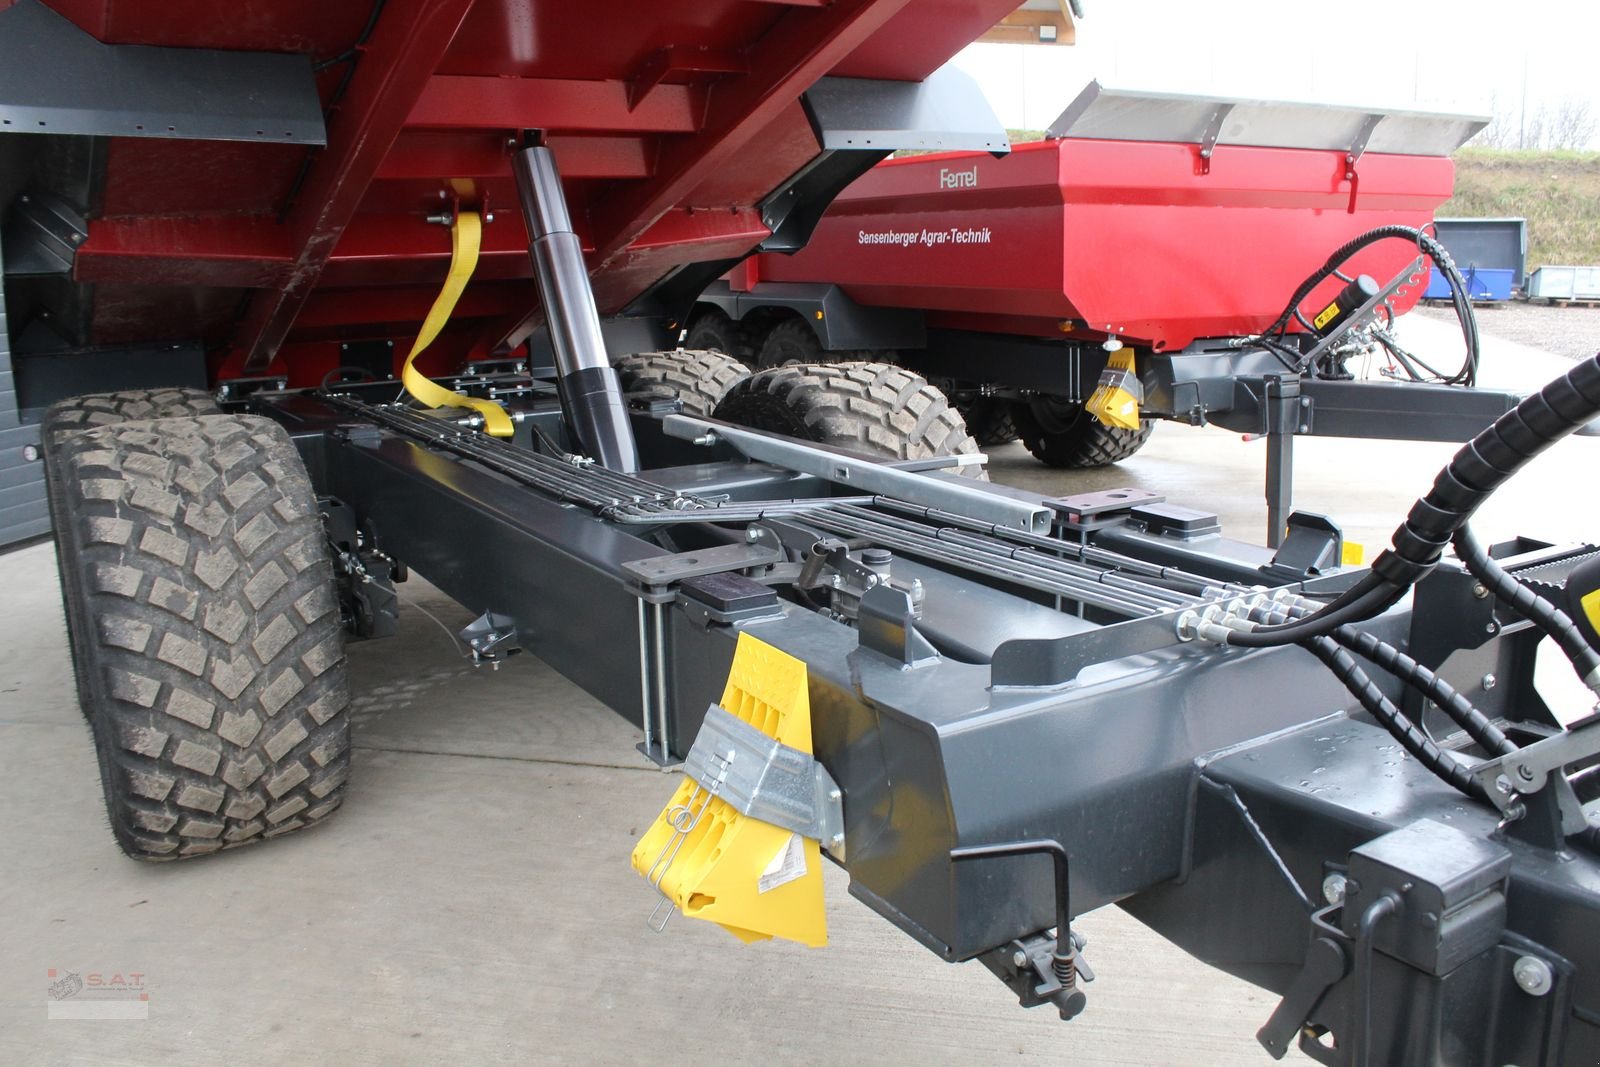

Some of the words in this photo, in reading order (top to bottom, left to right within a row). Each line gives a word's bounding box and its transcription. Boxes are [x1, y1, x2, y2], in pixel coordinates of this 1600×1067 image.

[940, 166, 977, 188] Ferrel
[858, 230, 919, 246] Sensenberger
[920, 227, 992, 247] Agrar-Technik
